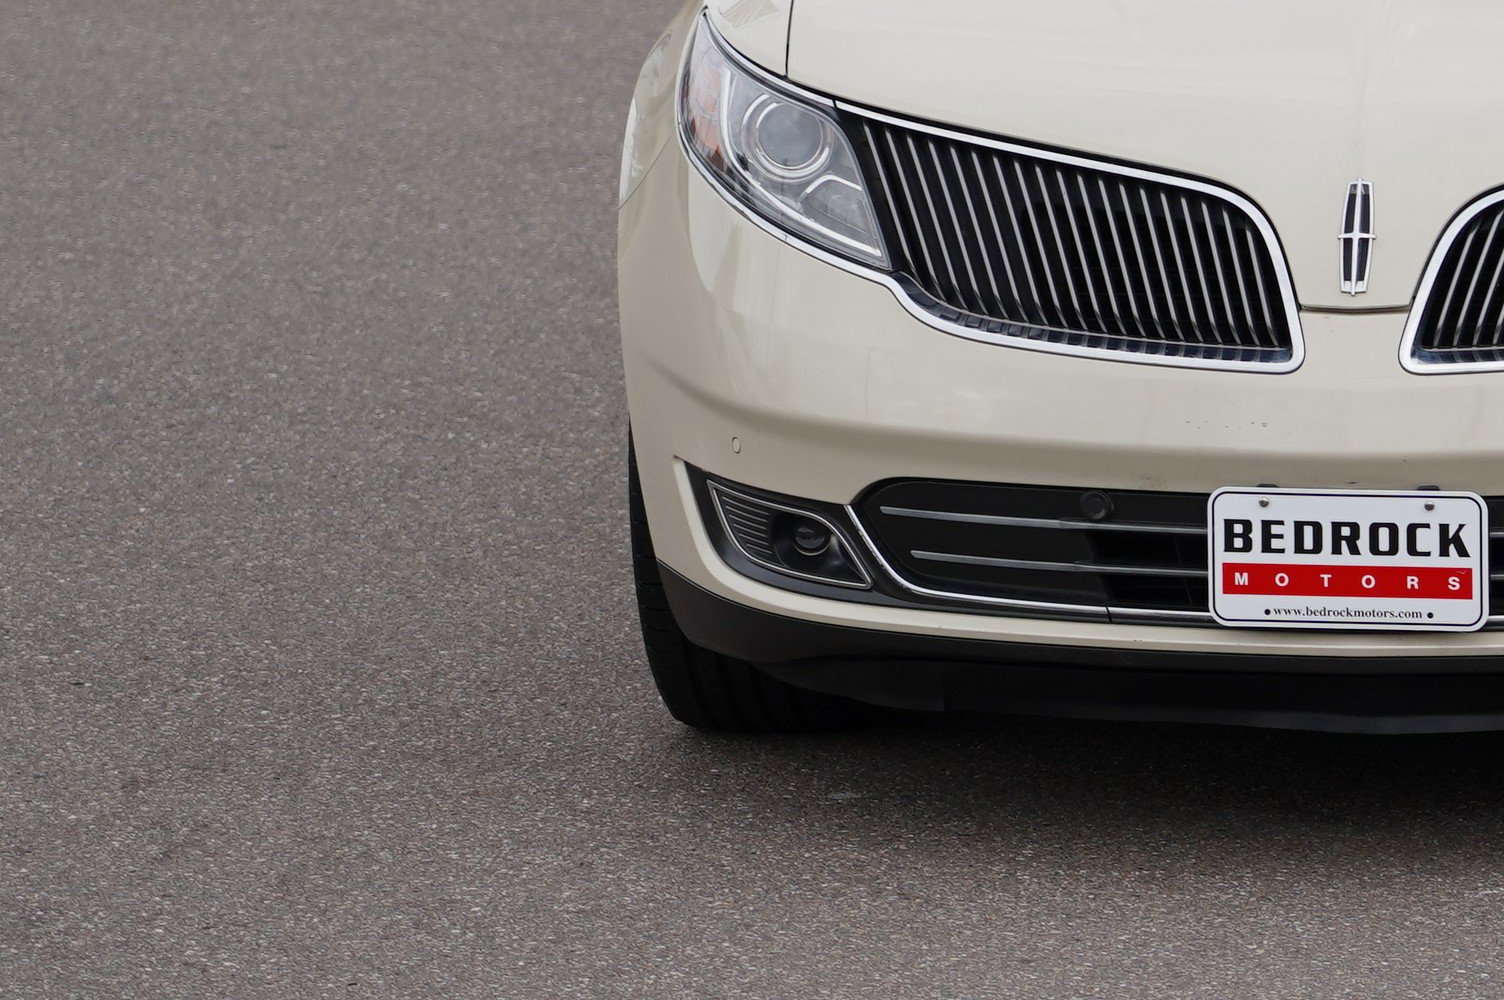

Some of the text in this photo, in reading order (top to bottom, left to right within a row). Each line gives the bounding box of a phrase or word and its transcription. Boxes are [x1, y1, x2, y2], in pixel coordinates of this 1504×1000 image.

[1223, 518, 1471, 558] BEDROCK
[1234, 572, 1461, 591] MOTORS
[1273, 606, 1423, 620] www.bedrockmotors.com
